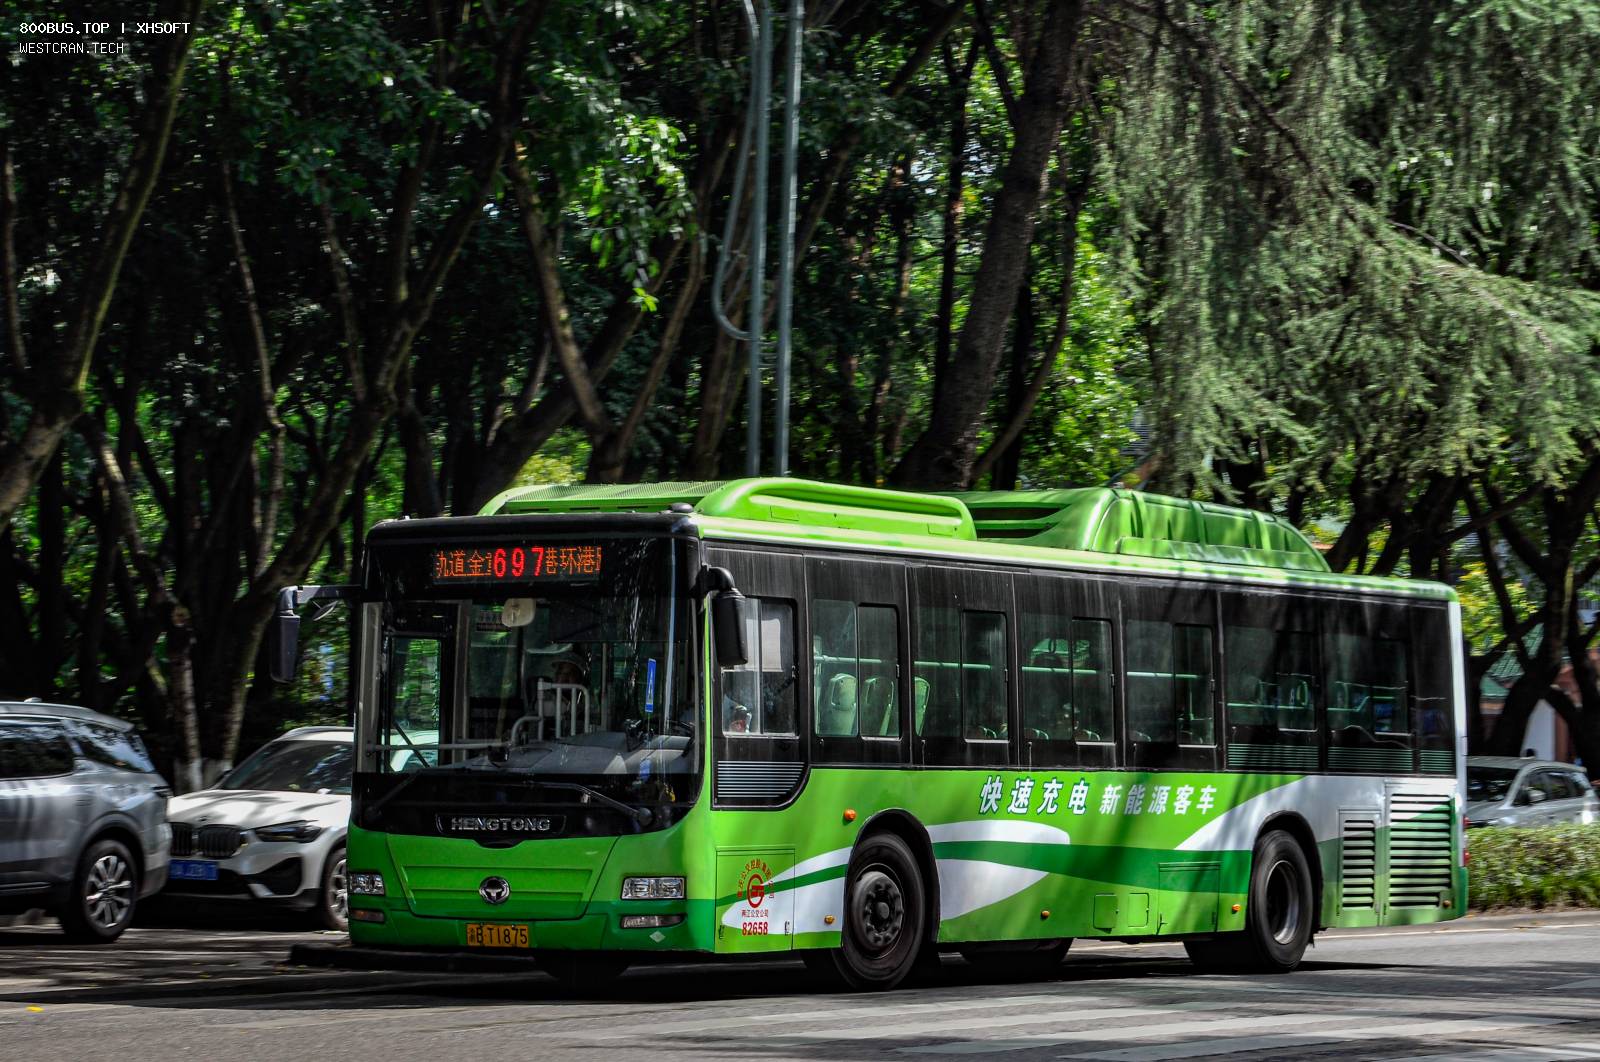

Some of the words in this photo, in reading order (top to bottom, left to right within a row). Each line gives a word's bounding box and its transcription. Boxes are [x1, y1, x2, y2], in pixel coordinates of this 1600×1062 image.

[493, 546, 545, 578] 697
[979, 774, 1090, 815] 快速充电
[1099, 783, 1217, 815] 新能源客车
[451, 817, 550, 831] HENGTONG
[742, 921, 769, 937] 82658
